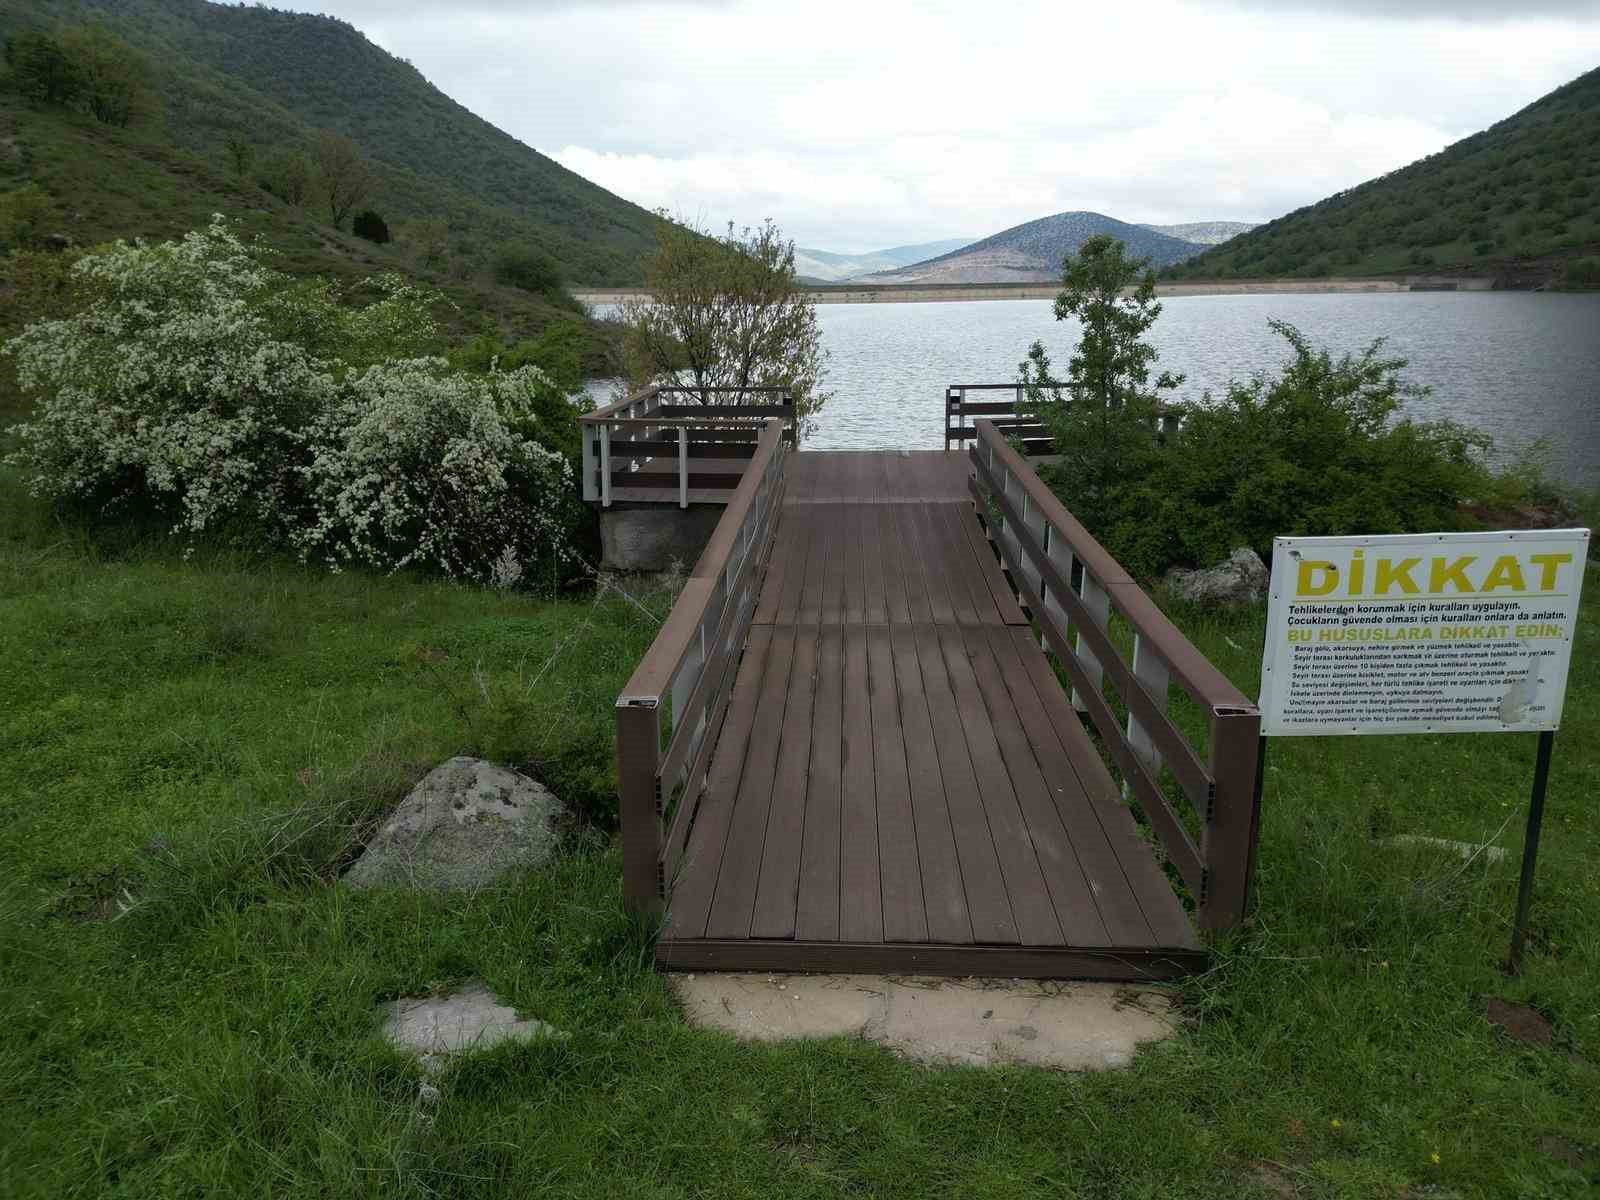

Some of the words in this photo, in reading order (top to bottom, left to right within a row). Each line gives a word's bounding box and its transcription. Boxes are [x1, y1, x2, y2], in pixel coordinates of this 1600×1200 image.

[1296, 550, 1572, 596] DİKKAT
[1289, 604, 1354, 615] Tehlikelerden
[1358, 603, 1405, 613] korunmak
[1408, 602, 1426, 614] için
[1429, 602, 1471, 612] kuralları
[1472, 602, 1520, 612] uygulayın.
[1288, 616, 1339, 627] Çocukların
[1342, 615, 1383, 627] güvende
[1386, 614, 1417, 624] olması
[1421, 613, 1438, 624] için
[1441, 612, 1481, 622] kuralları
[1484, 612, 1514, 621] onlara
[1517, 611, 1528, 621] da
[1531, 610, 1566, 620] anlatın.
[1288, 628, 1312, 642] BU
[1319, 626, 1432, 642] HUSUSLARA
[1295, 645, 1312, 653] Baraj
[1392, 644, 1415, 652] girmek
[1427, 643, 1452, 651] yüzmek
[1294, 654, 1311, 662] Seyir
[1334, 653, 1392, 661] korkuluklarından
[1293, 663, 1310, 671] Seyir
[1333, 662, 1358, 670] üzerine
[1370, 662, 1395, 670] kişiden
[1414, 662, 1438, 670] çıkmak
[1292, 672, 1309, 680] Seyir
[1302, 681, 1329, 689] seviyesi
[1488, 678, 1501, 686] için
[1290, 689, 1311, 697] İskele
[1369, 698, 1387, 706] baraj
[1411, 707, 1433, 715] uymak
[1435, 706, 1463, 714] güvende
[1373, 715, 1383, 723] hiç
[1396, 715, 1420, 723] şekilde
